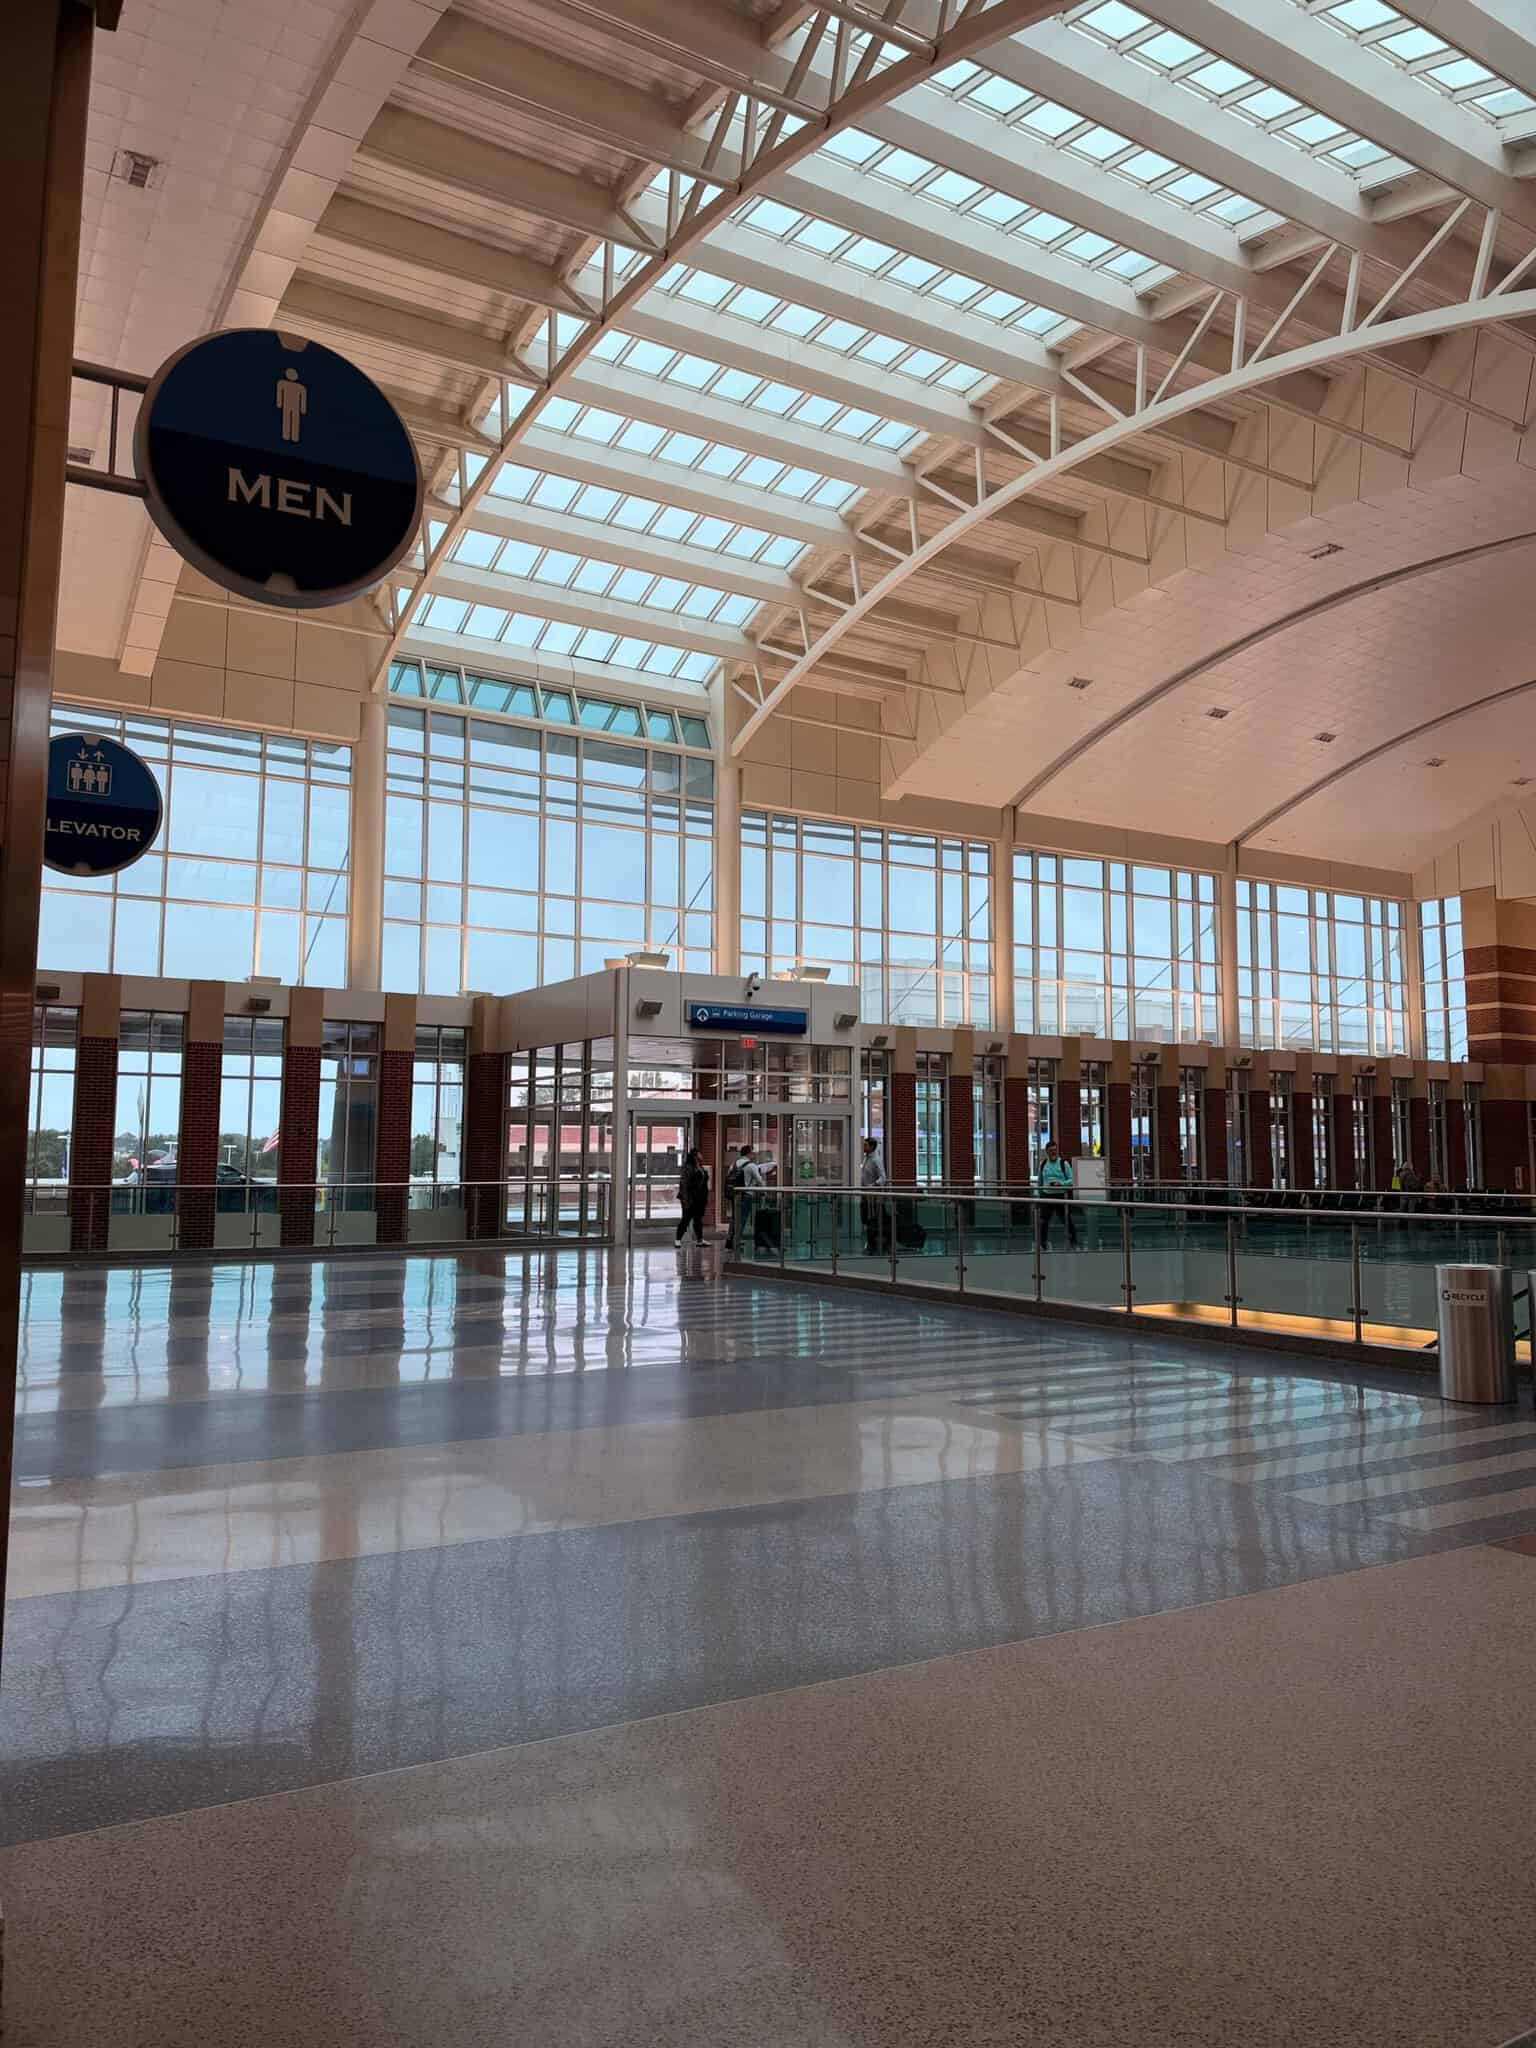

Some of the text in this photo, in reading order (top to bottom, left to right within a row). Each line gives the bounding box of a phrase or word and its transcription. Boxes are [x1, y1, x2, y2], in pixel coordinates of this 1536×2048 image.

[227, 466, 352, 526] MEN
[46, 818, 141, 842] LEVATOR
[723, 1009, 773, 1021] Parking Garage
[1451, 1292, 1485, 1302] RECYCLE
